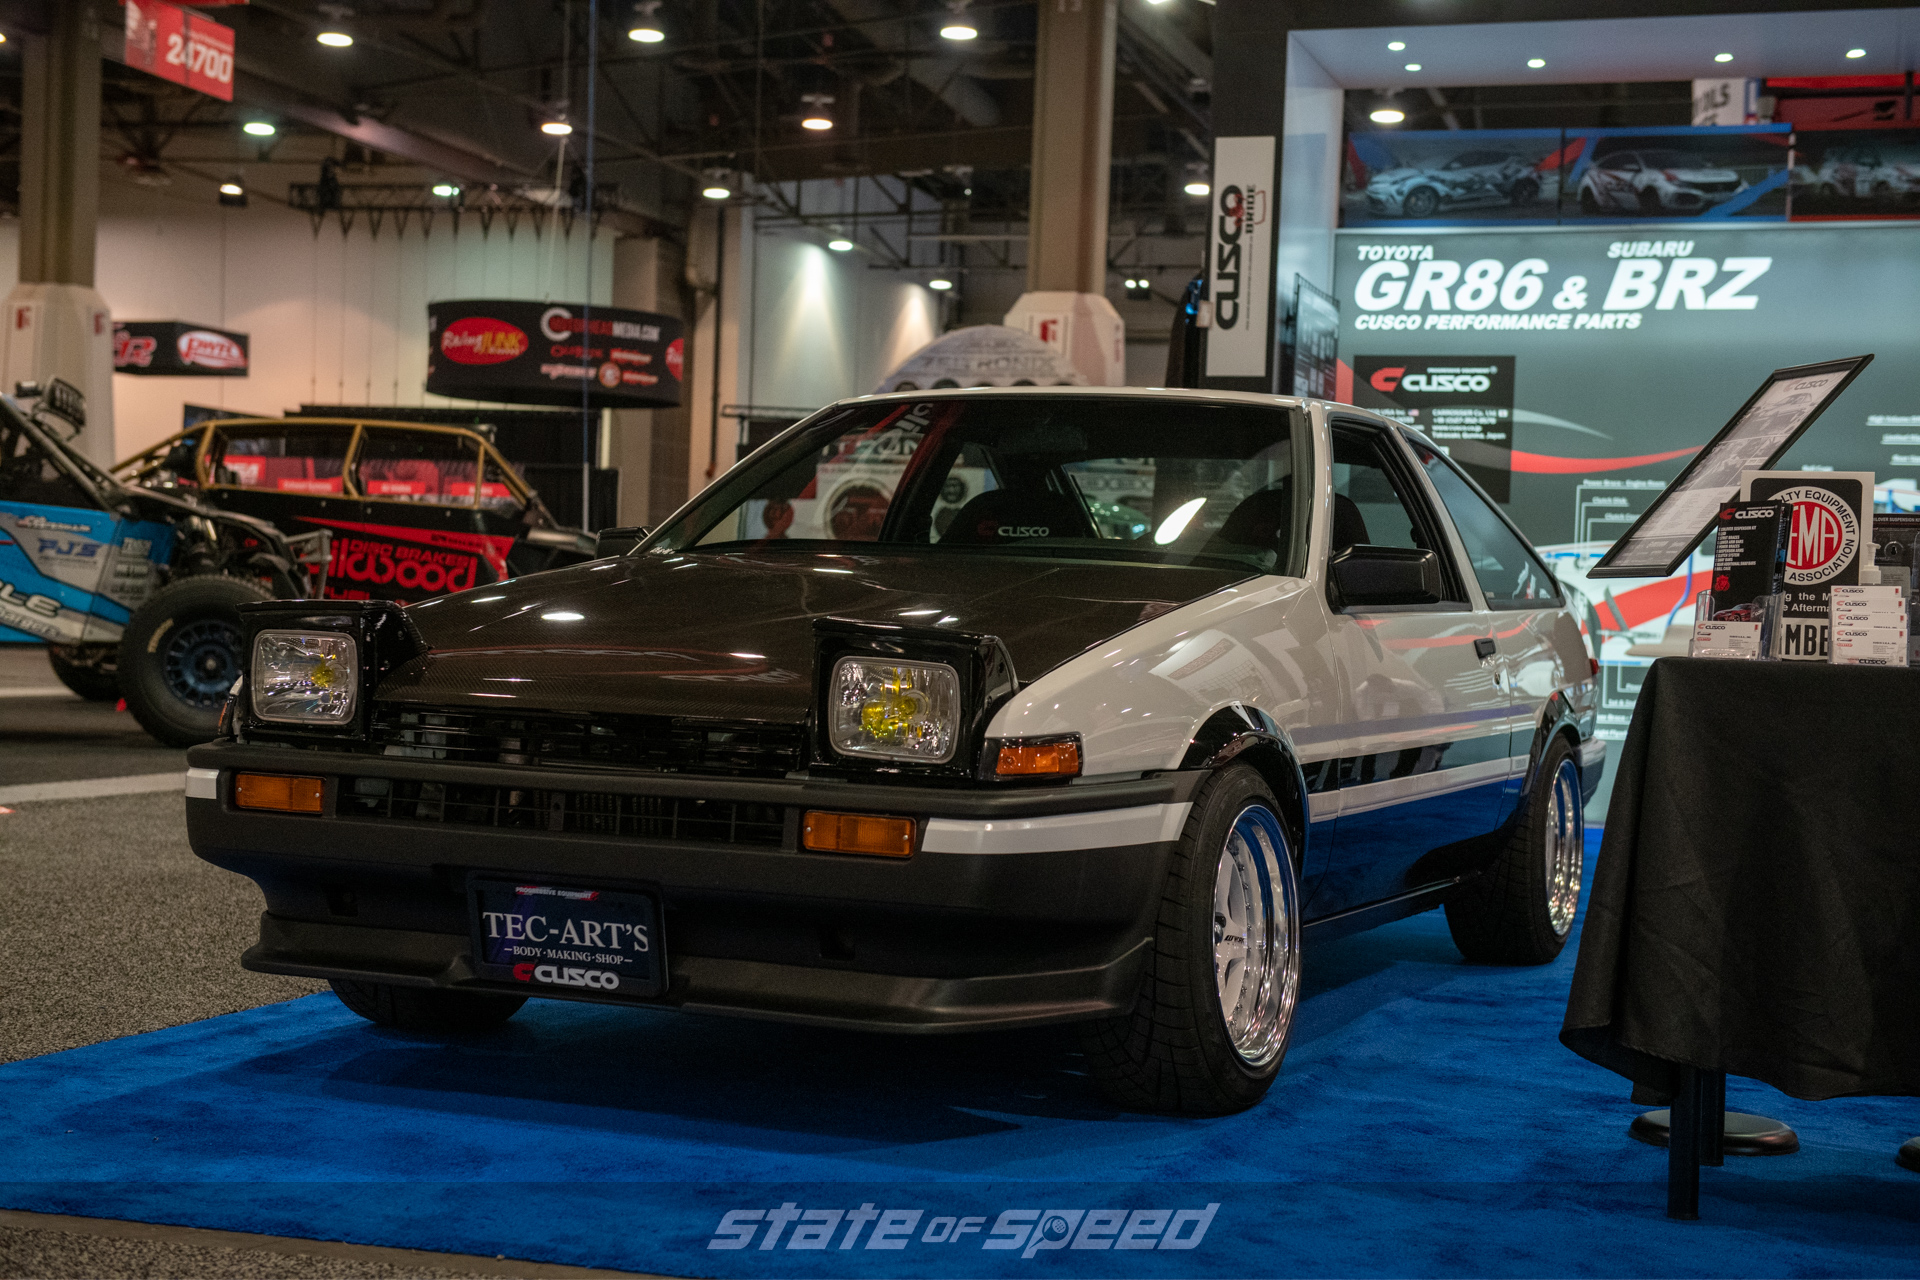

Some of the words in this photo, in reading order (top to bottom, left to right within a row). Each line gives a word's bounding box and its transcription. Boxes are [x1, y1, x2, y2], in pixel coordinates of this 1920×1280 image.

[1216, 184, 1243, 330] CUSCO
[1357, 245, 1434, 261] TOYOTA
[1607, 240, 1694, 258] SUBARU
[1354, 258, 1549, 311] GR86
[1552, 275, 1589, 310] &
[1602, 256, 1773, 310] BRZ
[1354, 314, 1422, 330] CUSCO
[1424, 313, 1571, 330] PERFORMANCE
[1574, 312, 1642, 329] PARTS
[1402, 374, 1491, 392] CUSCO
[1735, 510, 1774, 519] CUSCO
[1805, 490, 1856, 535] EQUIPMENT
[998, 526, 1049, 537] CUSCO
[1787, 504, 1839, 567] EMA
[1789, 539, 1856, 582] ASSOCIATION
[1799, 592, 1815, 601] the
[1780, 624, 1828, 656] MBE
[482, 911, 649, 952] TEC-ART'S
[534, 965, 620, 990] CUSCO
